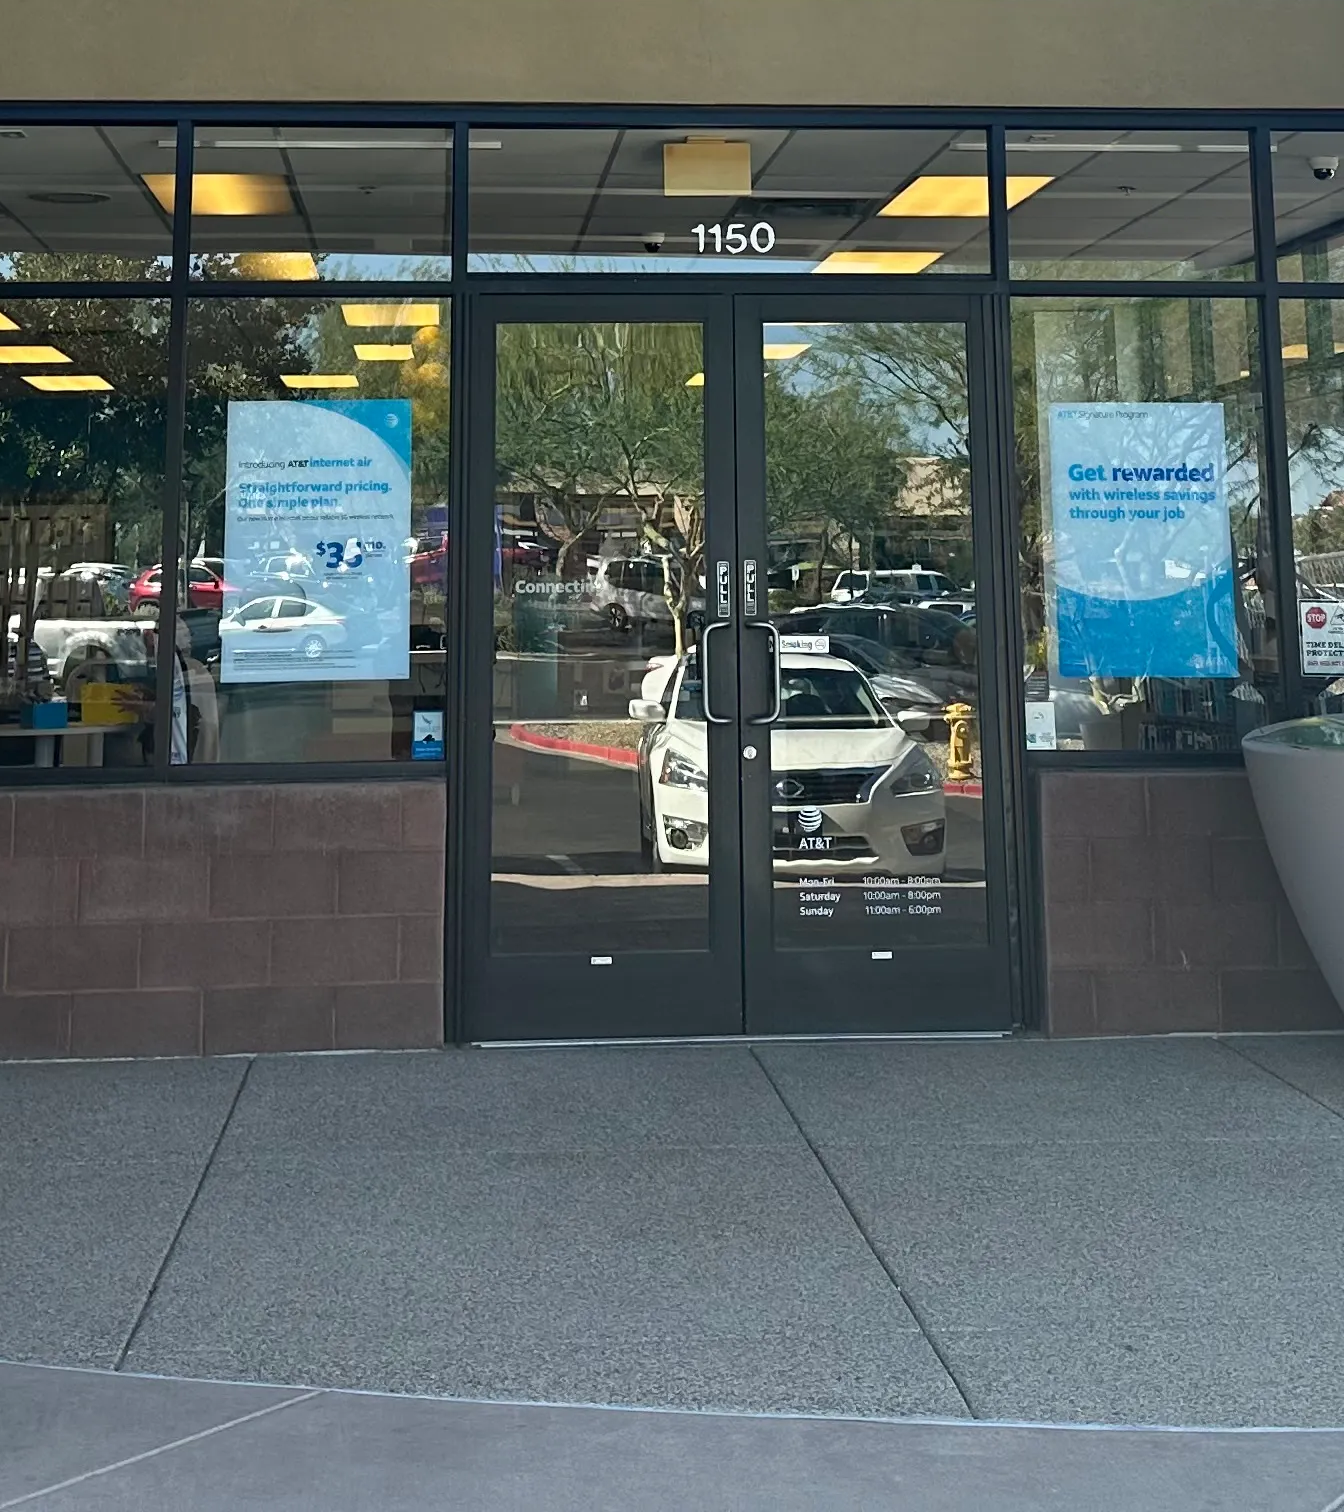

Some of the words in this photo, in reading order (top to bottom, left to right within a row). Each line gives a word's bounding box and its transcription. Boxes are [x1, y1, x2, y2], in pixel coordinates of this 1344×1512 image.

[691, 221, 776, 254] 1150
[238, 459, 286, 470] Introducing
[287, 459, 309, 468] AT&T
[309, 456, 355, 468] internet
[357, 456, 373, 468] air
[1068, 463, 1107, 482] Get
[1112, 463, 1215, 482] rewarded
[238, 481, 343, 496] Straightforward
[1068, 487, 1101, 501] with
[1104, 487, 1161, 501] wireless
[1163, 488, 1216, 504] savings
[238, 497, 265, 509] One
[266, 496, 309, 511] simple
[1069, 506, 1126, 522] through
[1129, 508, 1161, 522] your
[1162, 506, 1186, 523] job
[514, 578, 602, 597] Connectin
[719, 566, 728, 604] PULL
[746, 564, 755, 602] PULL
[1306, 613, 1326, 623] STOP
[1306, 641, 1327, 649] TIME
[798, 836, 833, 850] AT&T
[798, 891, 841, 903] Saturday
[862, 890, 901, 900] 10:00am
[907, 890, 942, 902] 8:00pm
[798, 906, 835, 918] Sunday
[864, 905, 901, 915] 11:00am
